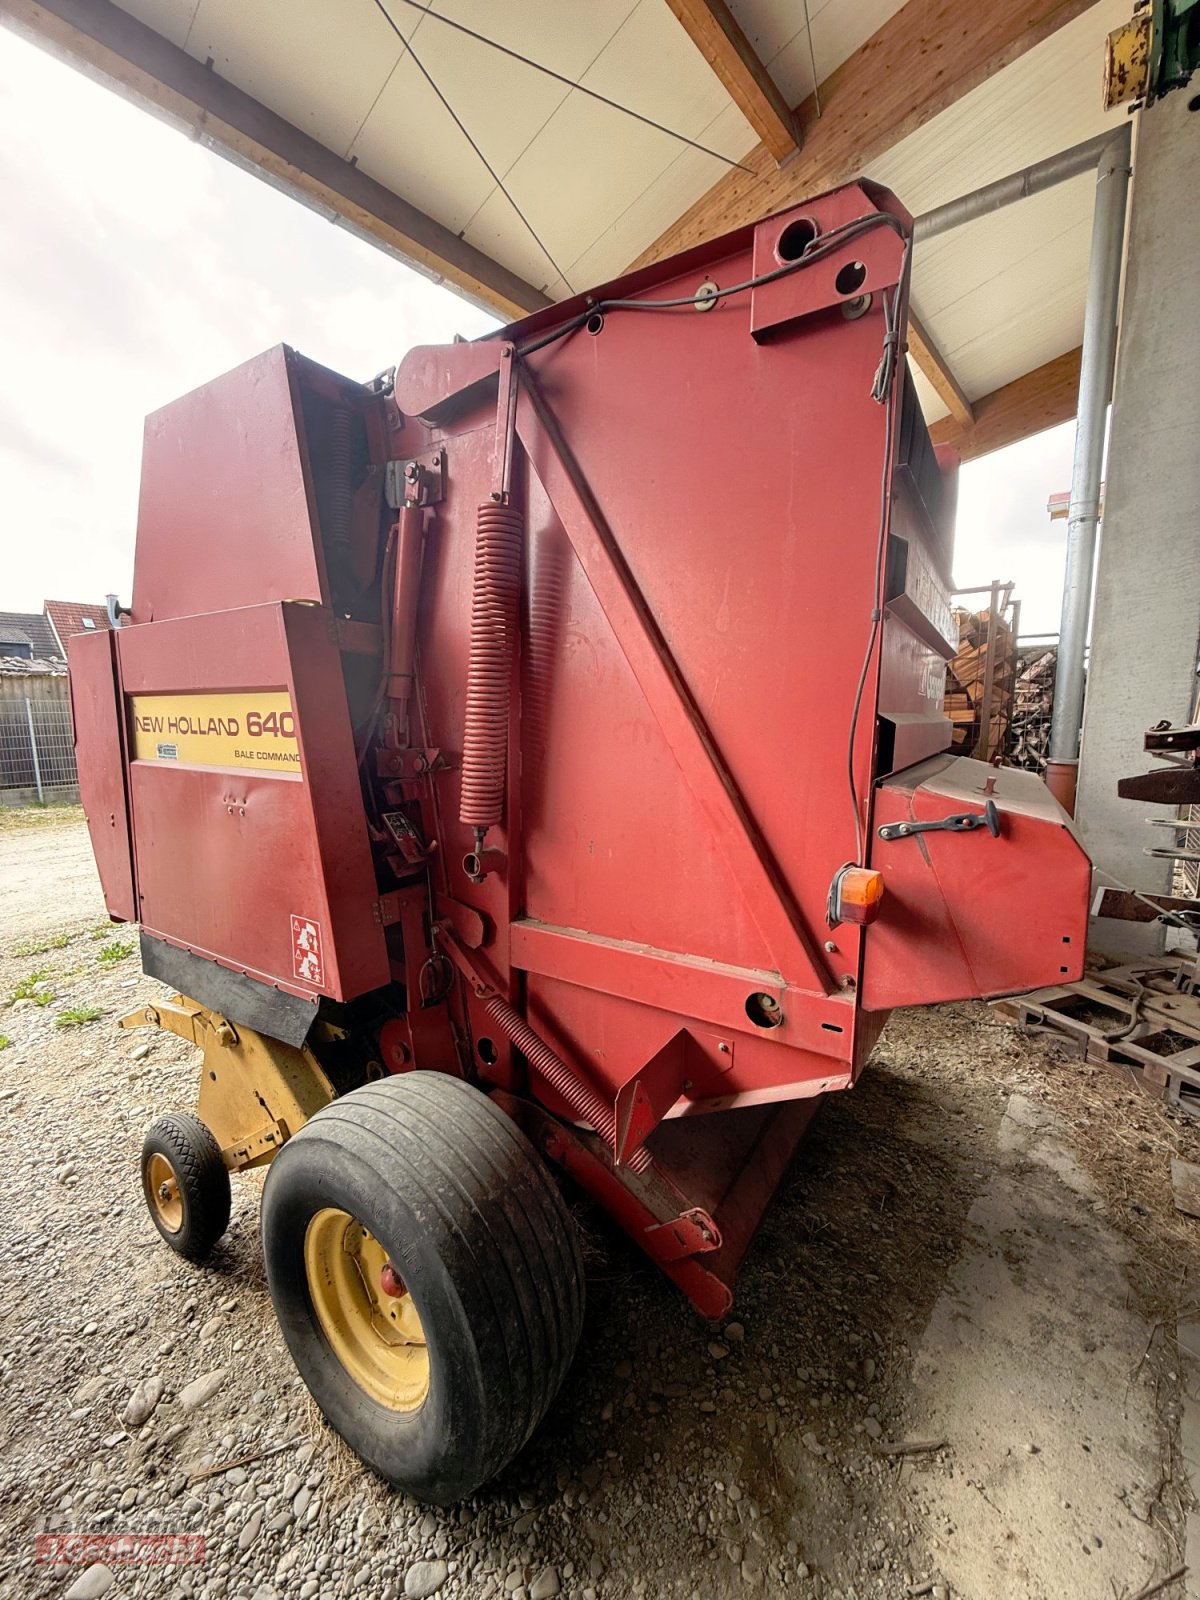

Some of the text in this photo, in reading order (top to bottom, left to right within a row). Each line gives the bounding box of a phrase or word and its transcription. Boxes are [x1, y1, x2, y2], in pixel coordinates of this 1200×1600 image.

[135, 711, 298, 739] NEW HOLLAND 640
[234, 749, 302, 763] BALE COMMAND
